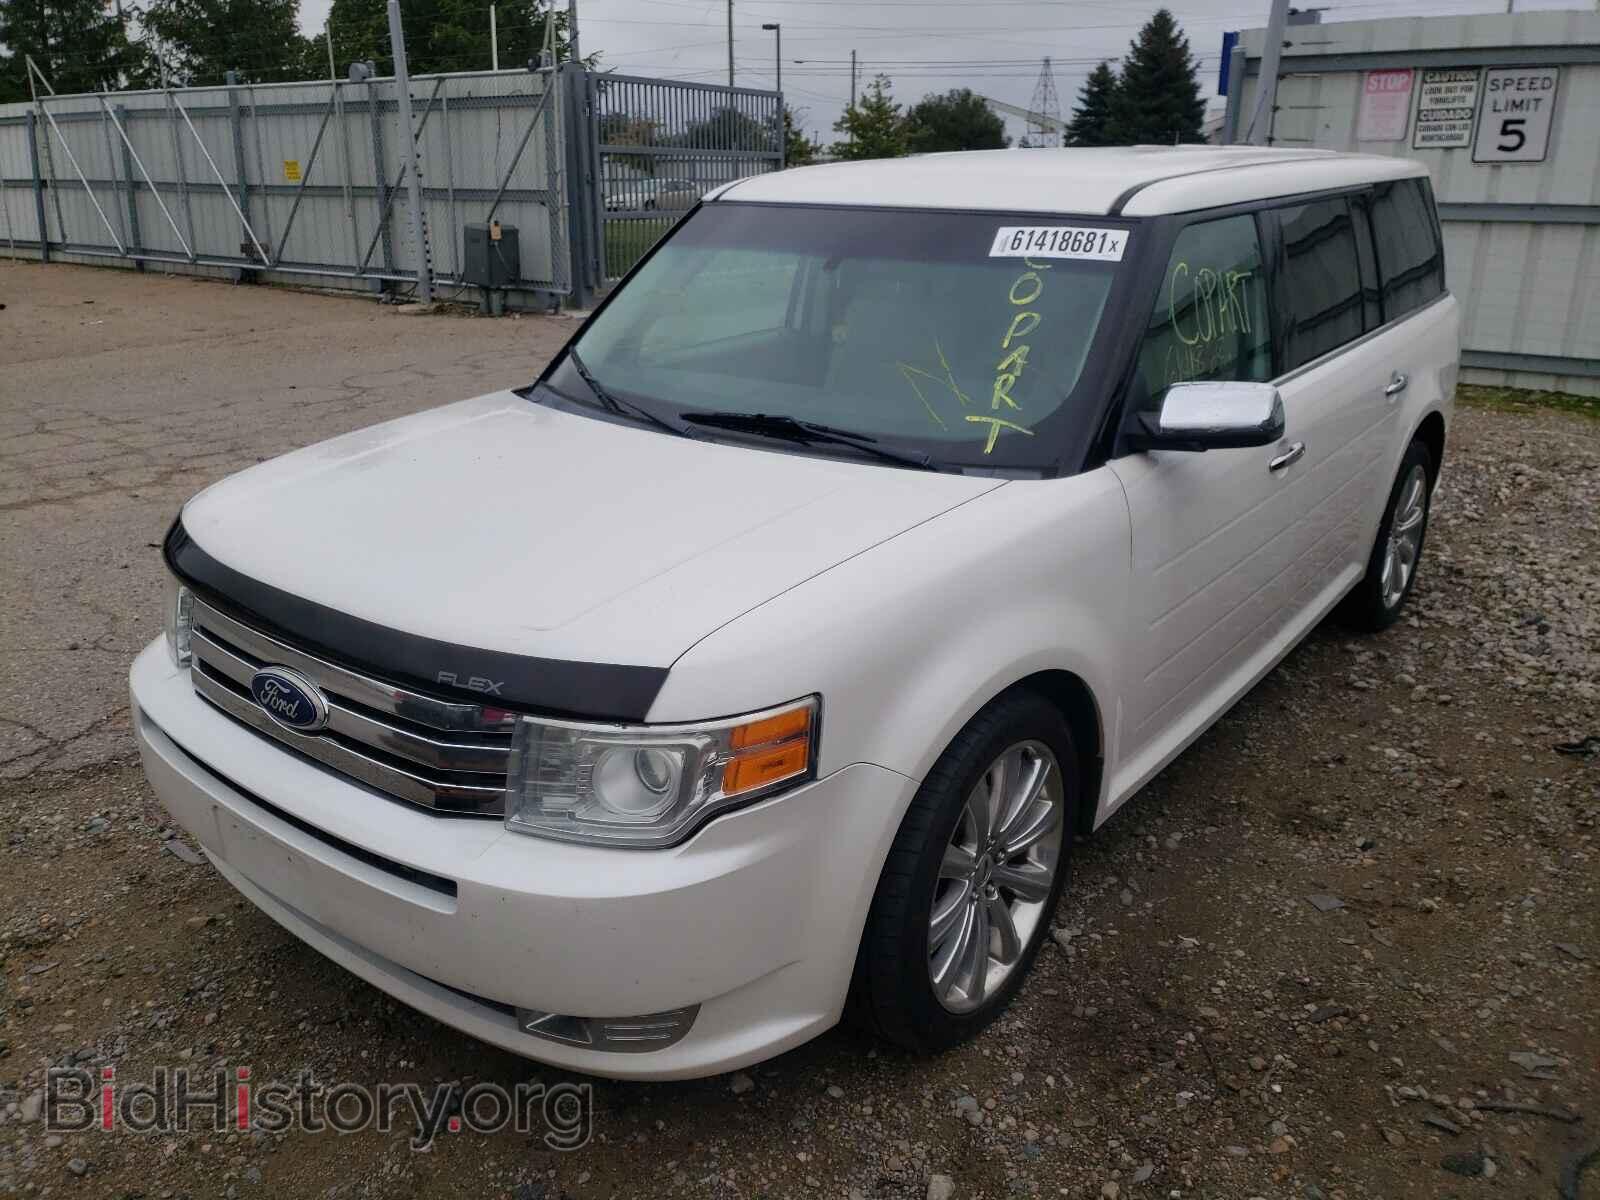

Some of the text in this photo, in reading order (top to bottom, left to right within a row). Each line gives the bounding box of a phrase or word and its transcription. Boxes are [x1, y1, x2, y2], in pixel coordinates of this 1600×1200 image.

[1367, 73, 1409, 90] STOP
[1490, 77, 1553, 92] SPEED
[1493, 98, 1544, 113] LIMIT
[1497, 119, 1527, 152] 5
[437, 670, 504, 695] FLEX
[260, 679, 299, 719] Ford
